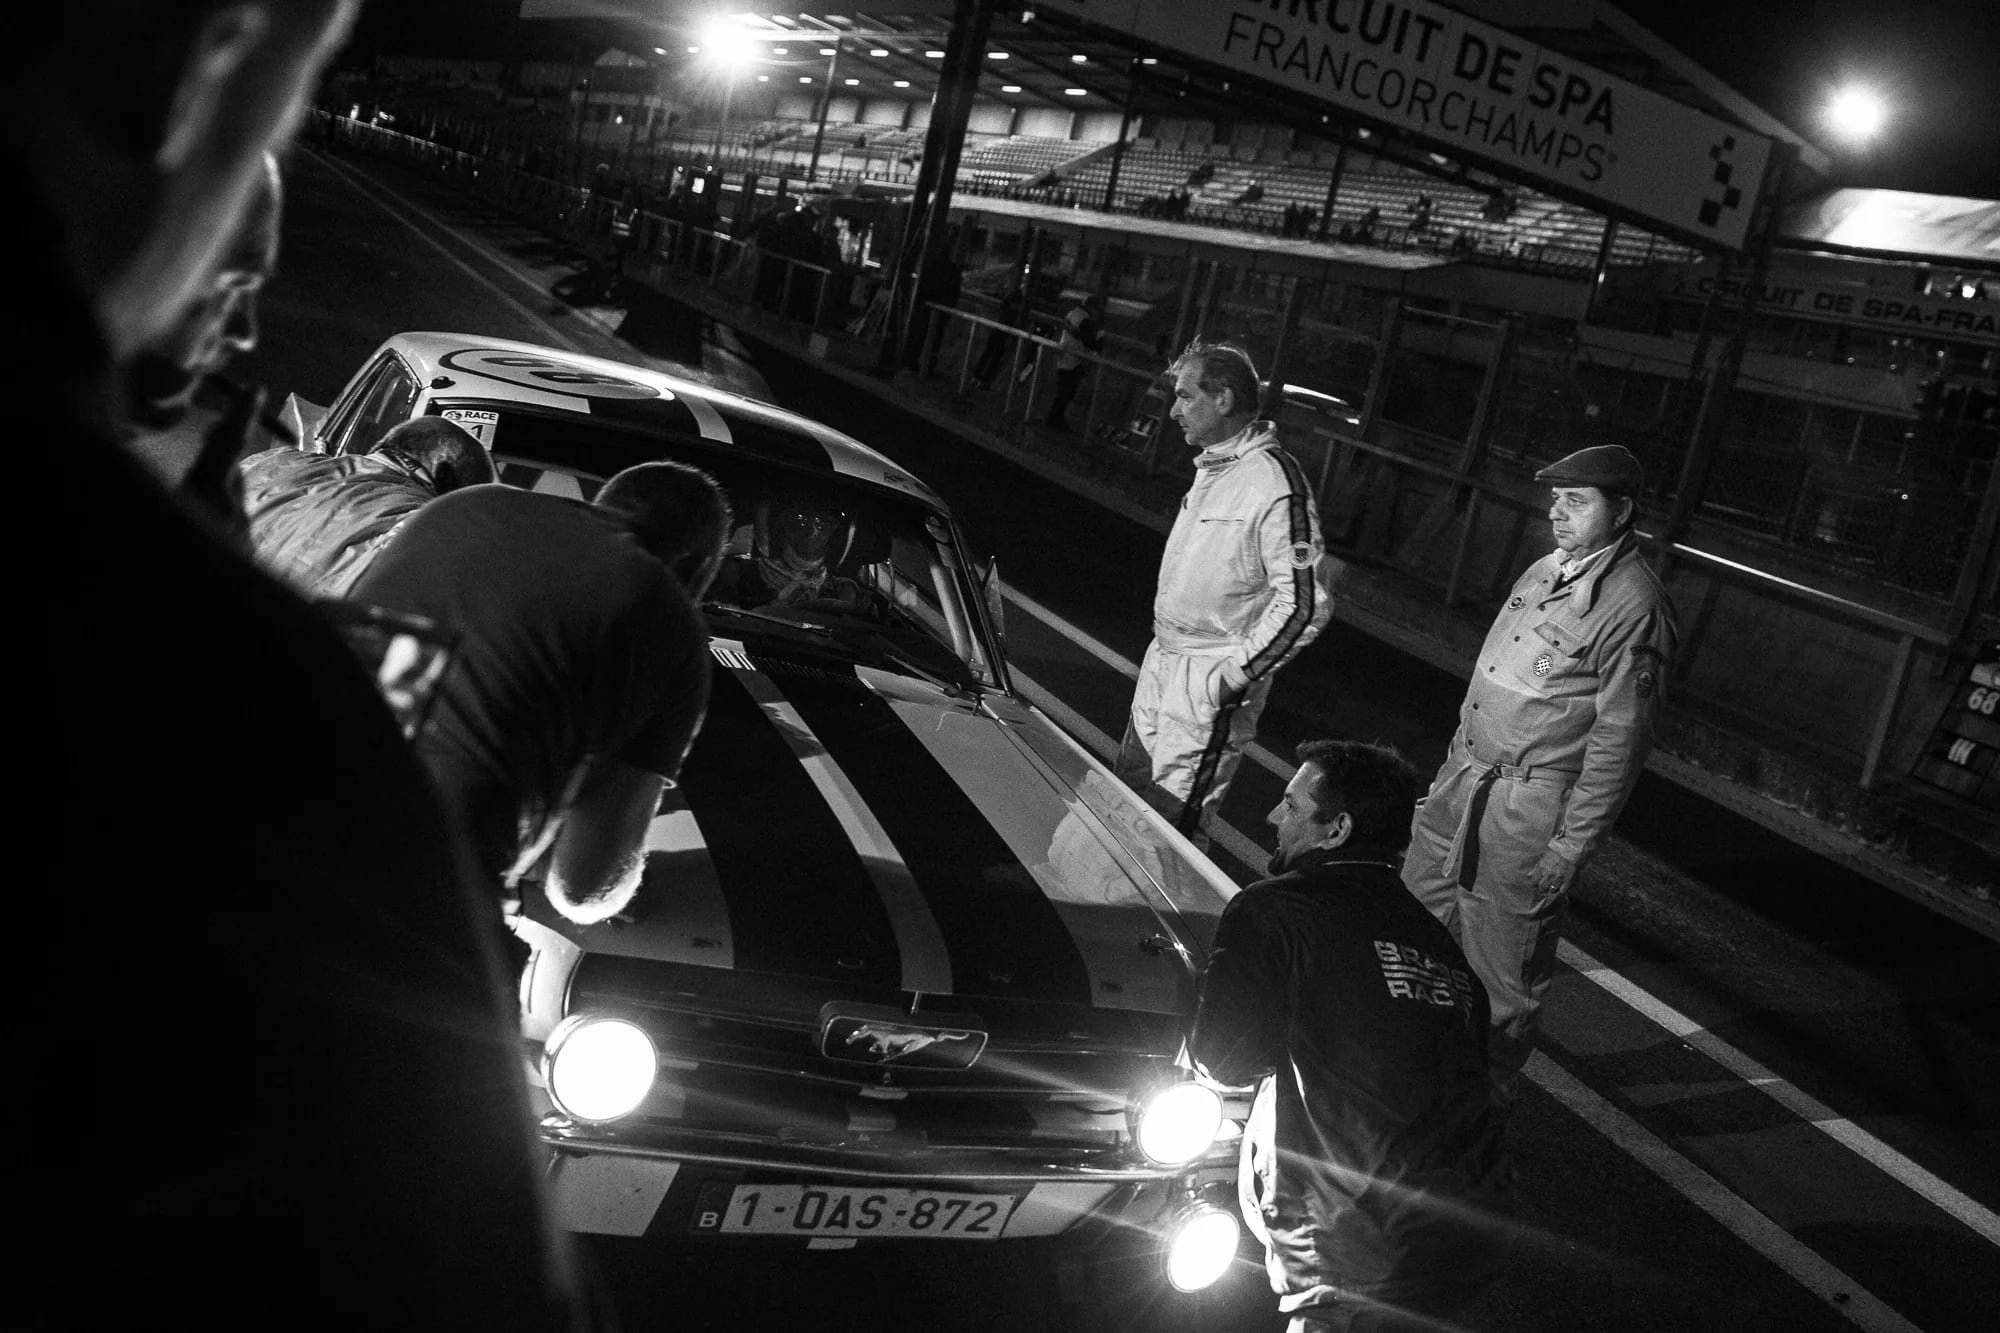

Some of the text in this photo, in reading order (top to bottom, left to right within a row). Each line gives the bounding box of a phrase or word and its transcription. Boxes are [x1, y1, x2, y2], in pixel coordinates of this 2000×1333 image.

[1224, 12, 1606, 182] FRANCORCHAMPS
[1454, 32, 1522, 95] DE
[1528, 64, 1613, 135] SPA
[1814, 292, 1854, 314] DE
[1863, 299, 2000, 336] SPA-FRA
[464, 411, 497, 421] RACE
[698, 1211, 719, 1228] B
